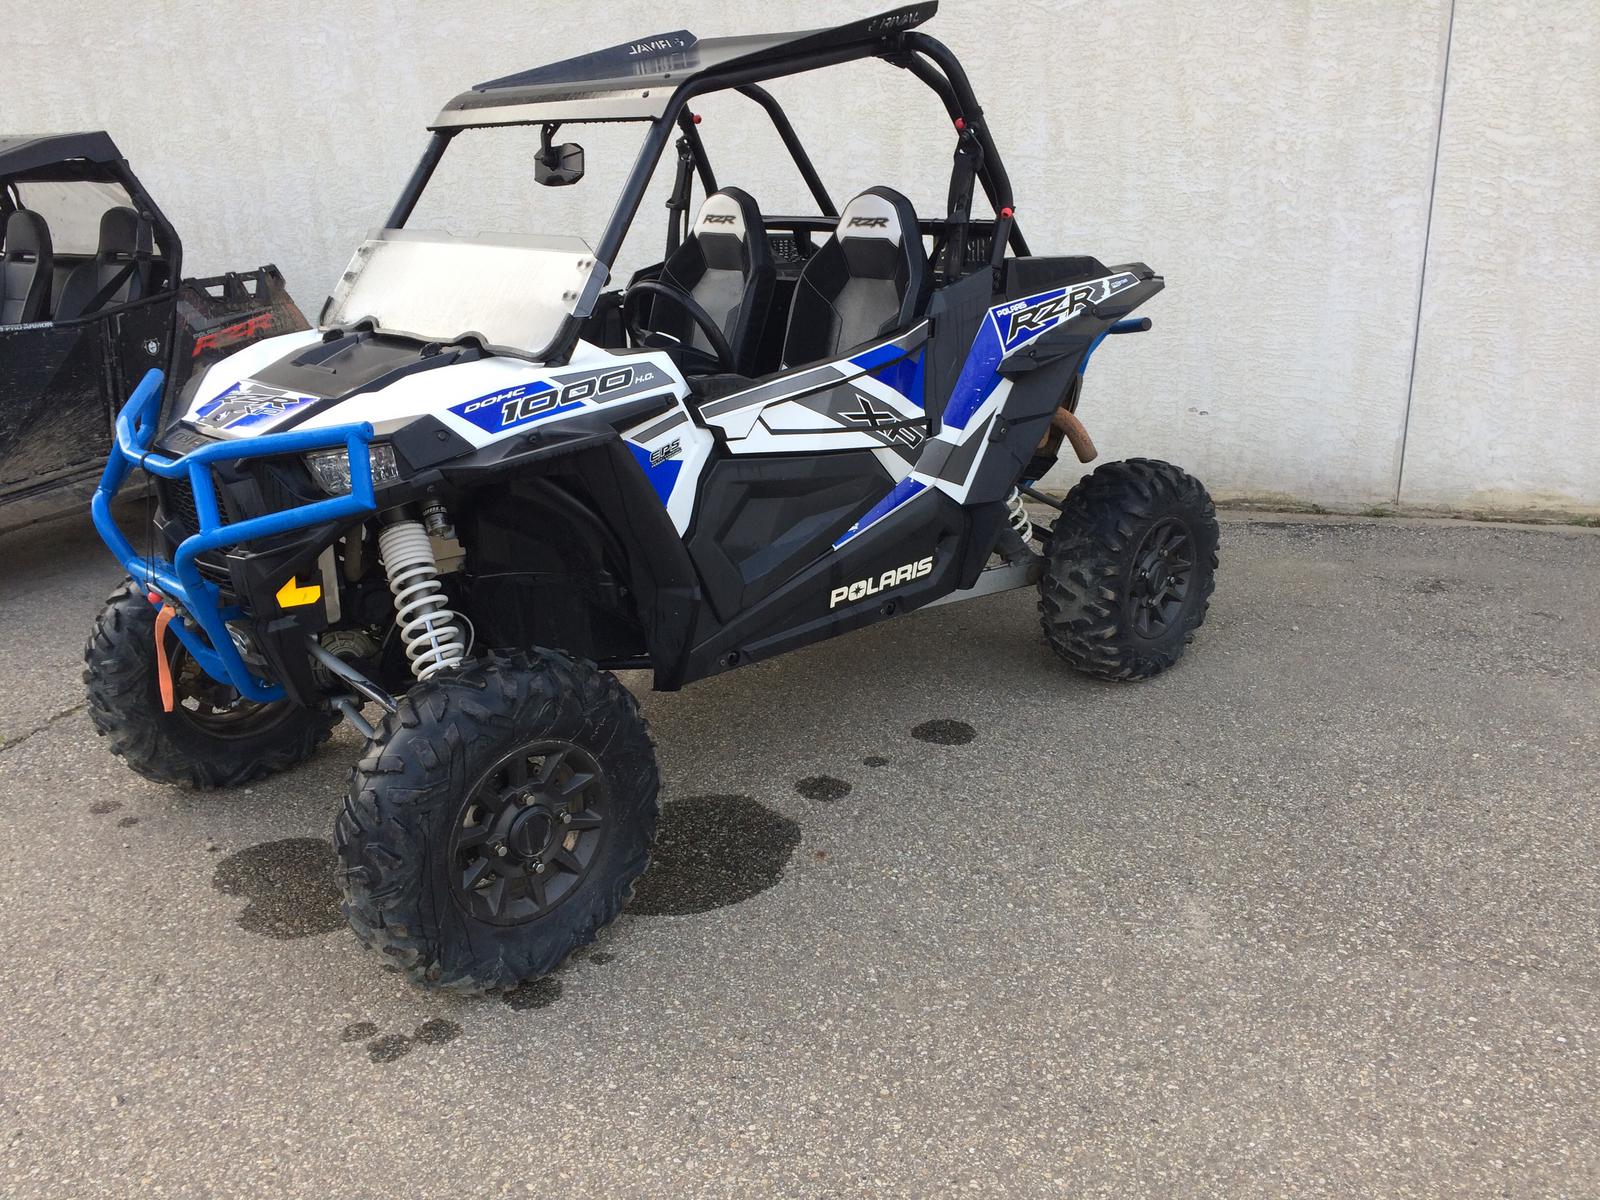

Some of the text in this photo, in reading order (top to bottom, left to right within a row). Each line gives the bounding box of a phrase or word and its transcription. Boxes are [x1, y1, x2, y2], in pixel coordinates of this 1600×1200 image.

[703, 214, 736, 225] RZR
[848, 217, 889, 228] RZR
[996, 301, 1028, 317] POLARIS
[1005, 286, 1098, 345] RZR
[23, 321, 54, 330] ARMOR
[464, 387, 526, 413] DOHC
[501, 366, 655, 426] 1000 H.O.
[650, 438, 680, 463] EPS
[830, 556, 933, 608] POLARIS
